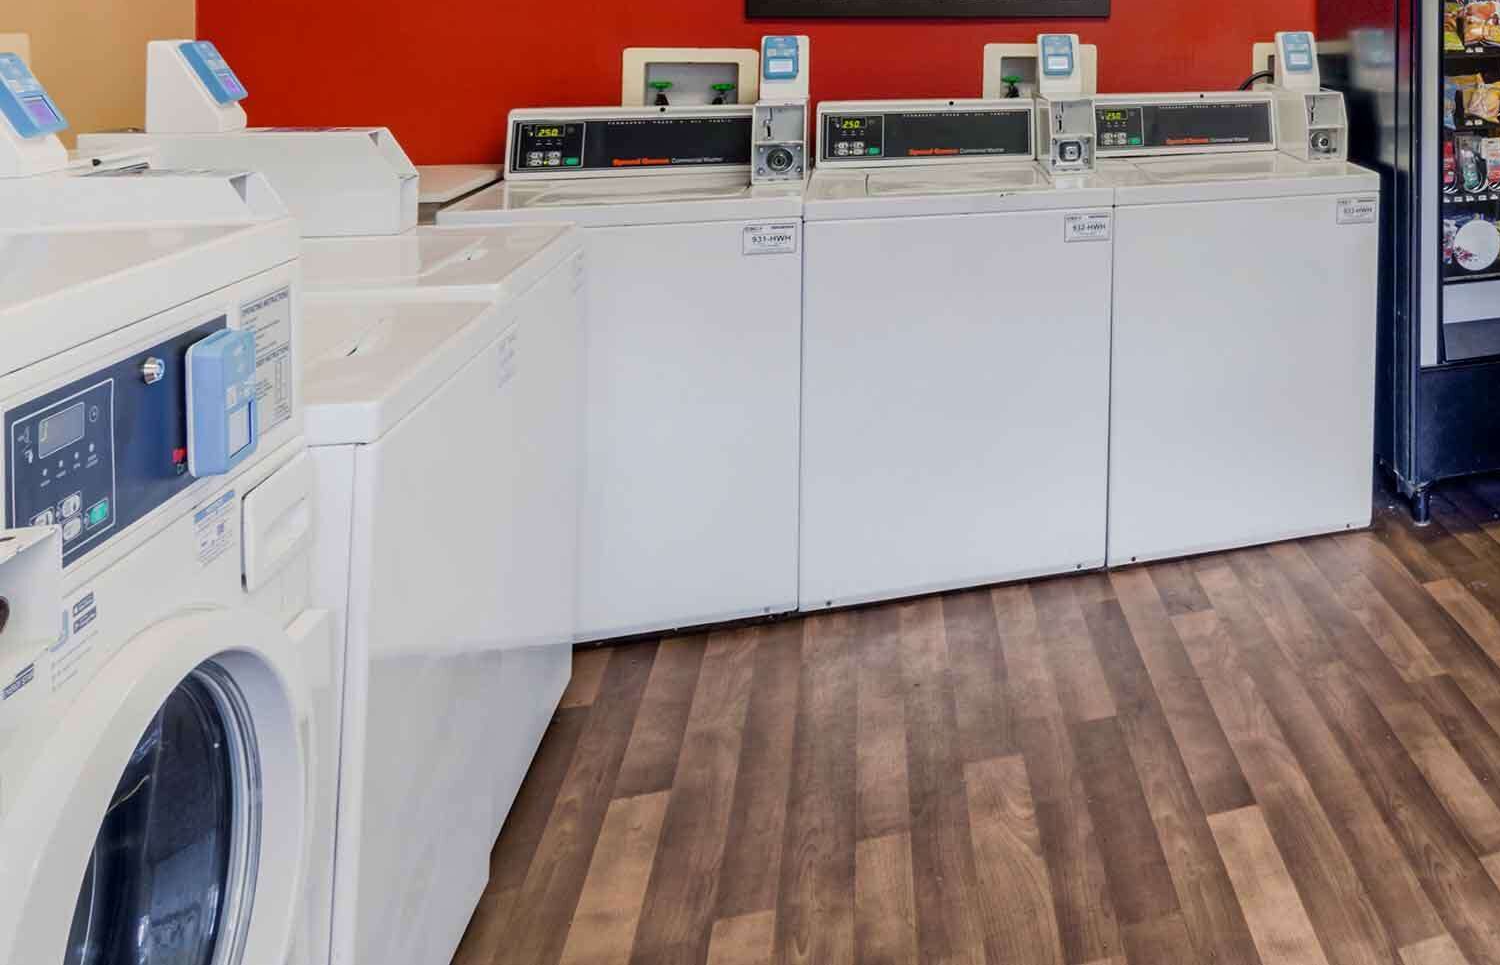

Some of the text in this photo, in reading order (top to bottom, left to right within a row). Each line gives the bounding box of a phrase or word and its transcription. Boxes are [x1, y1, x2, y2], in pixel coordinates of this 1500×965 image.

[1105, 112, 1121, 120] 250
[842, 120, 860, 129] 250
[537, 128, 559, 136] 250
